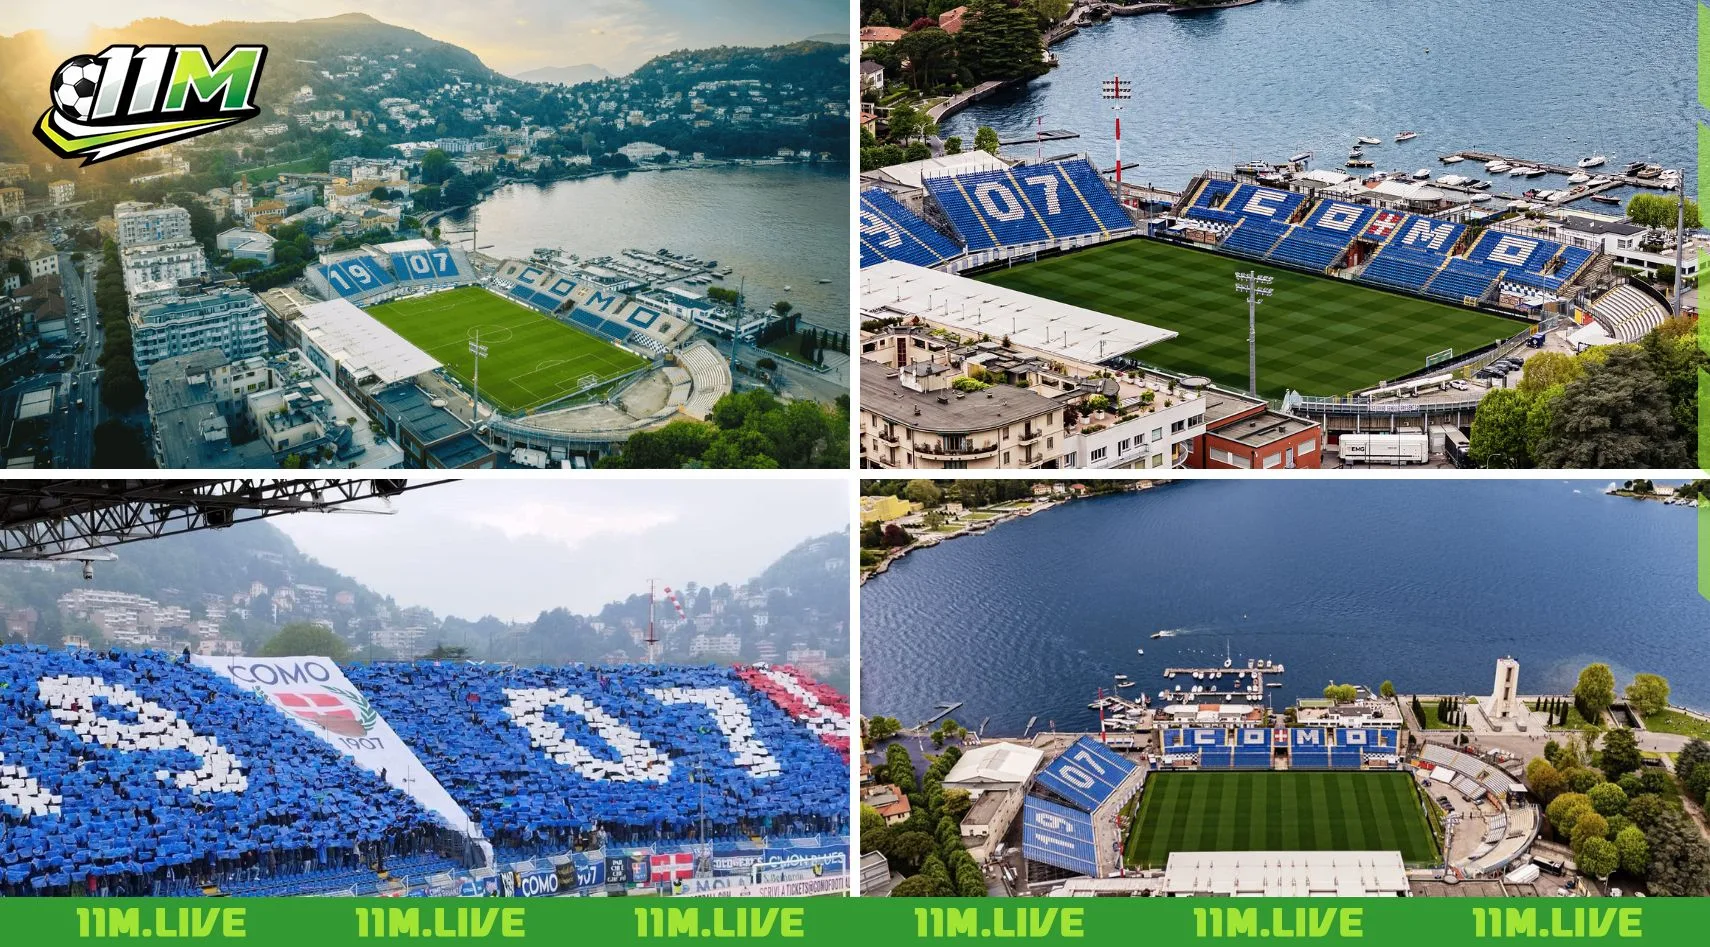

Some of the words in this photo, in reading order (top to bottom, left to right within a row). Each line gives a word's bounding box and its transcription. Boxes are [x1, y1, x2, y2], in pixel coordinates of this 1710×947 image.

[974, 175, 1061, 221] 07
[1243, 189, 1538, 266] COMO
[516, 266, 661, 329] COMO
[228, 661, 330, 685] COMO
[338, 737, 385, 750] 1907
[1194, 729, 1367, 745] COMO
[521, 873, 558, 897] COMO
